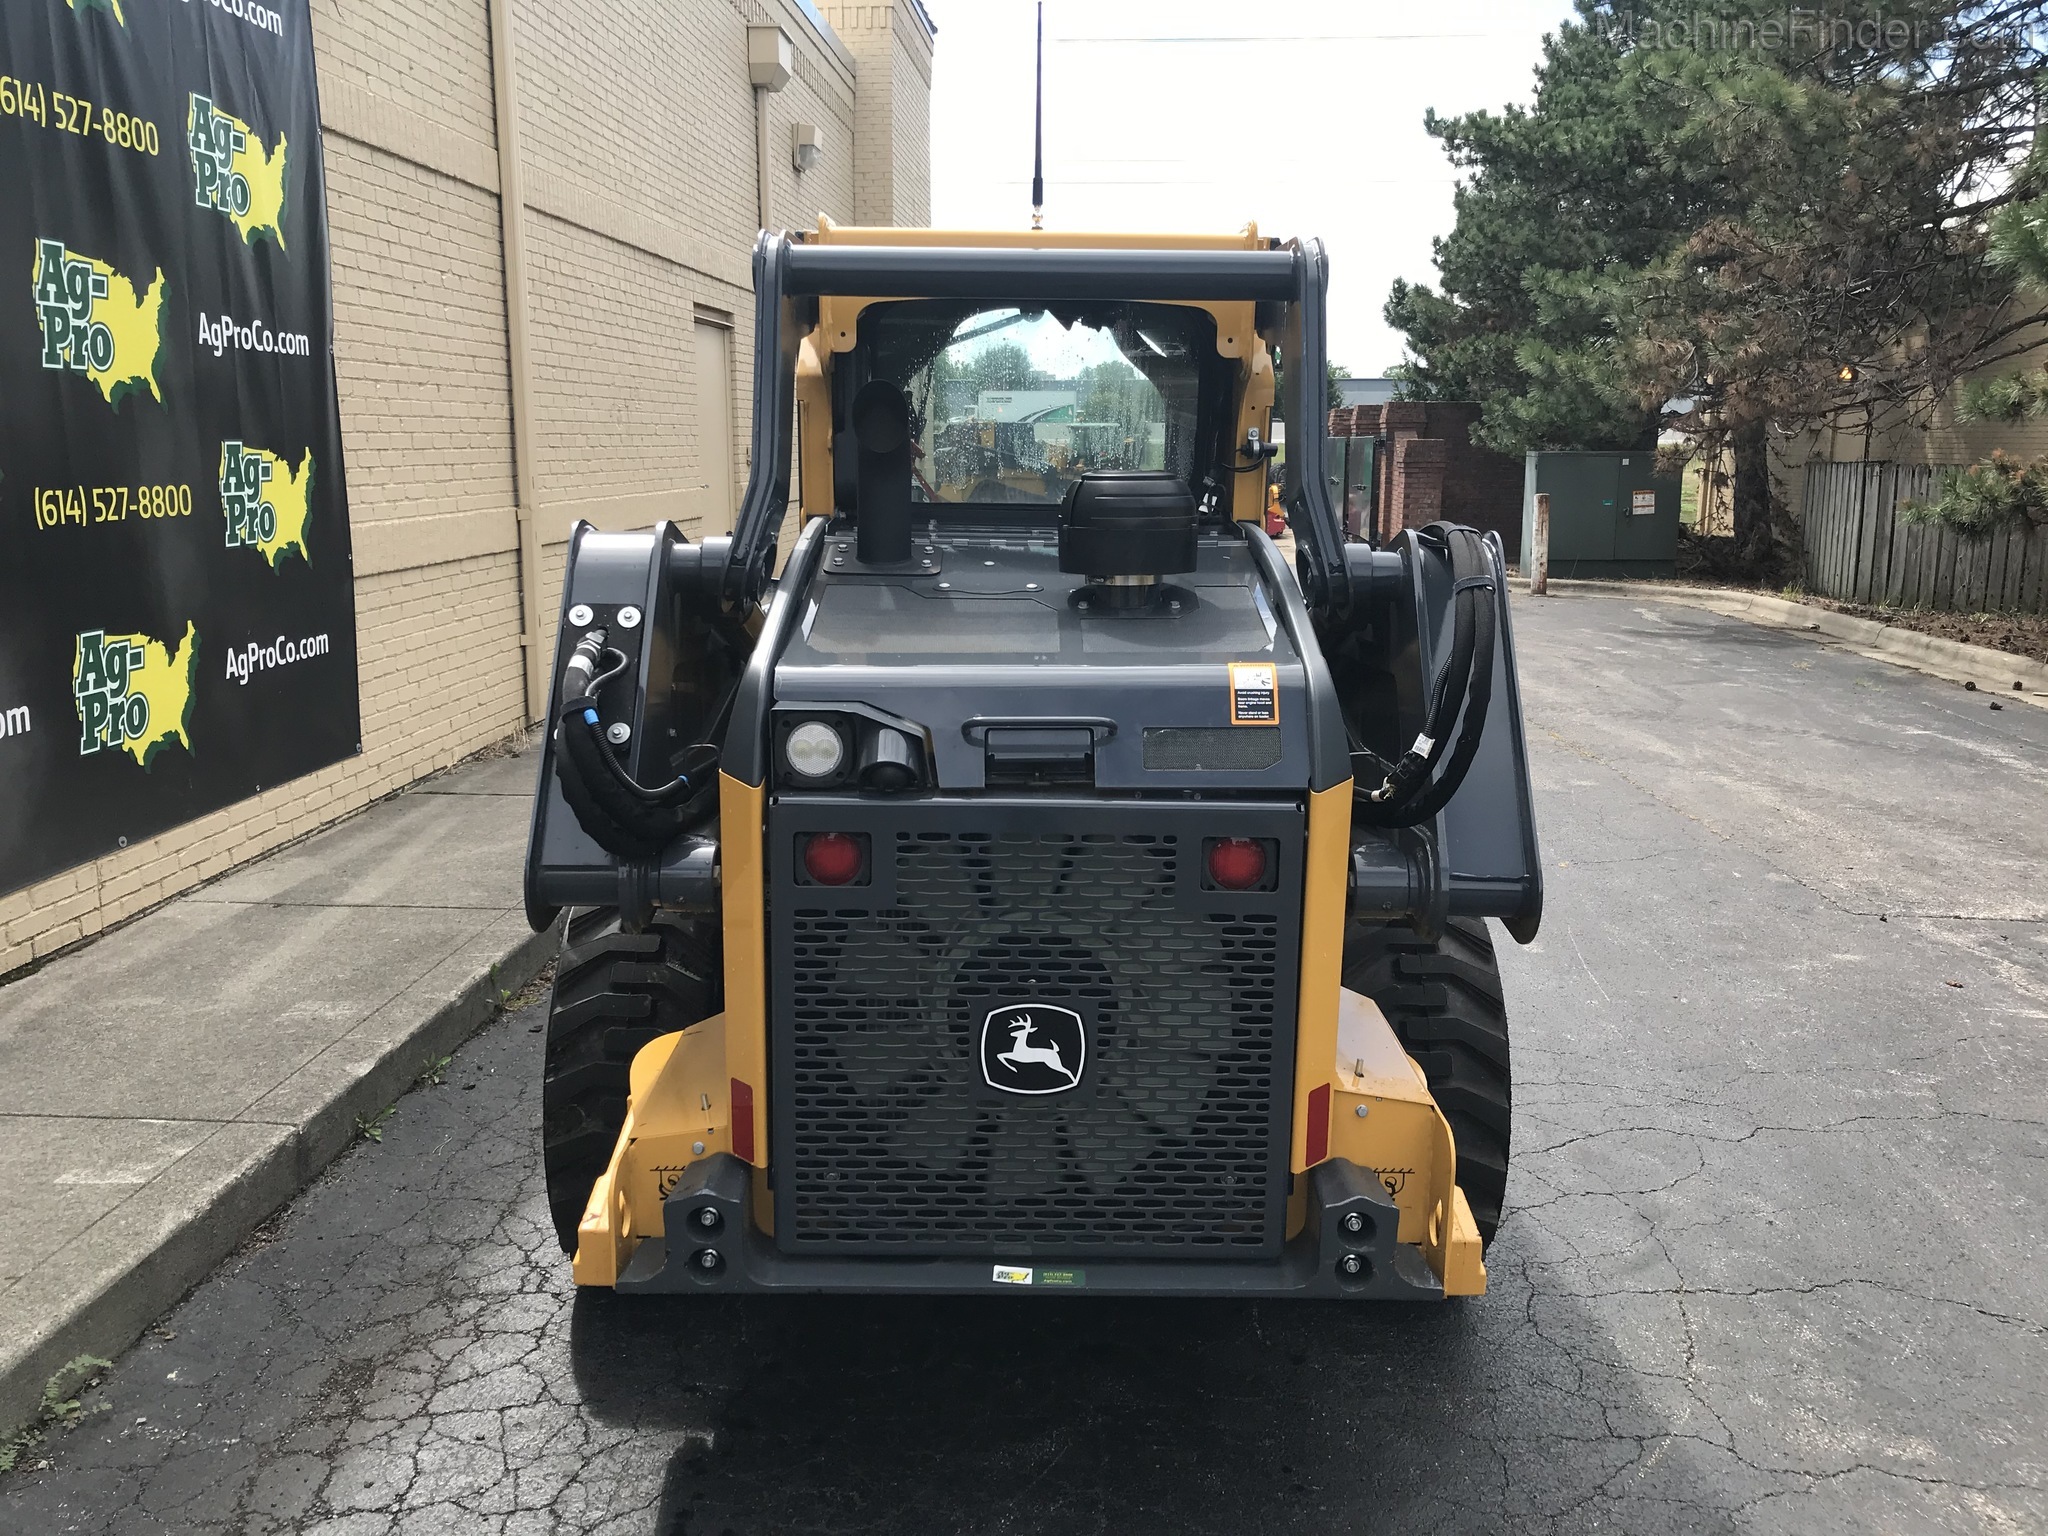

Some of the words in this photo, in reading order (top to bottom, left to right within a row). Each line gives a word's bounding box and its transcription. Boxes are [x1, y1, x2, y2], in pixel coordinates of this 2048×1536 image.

[0, 75, 46, 128] 614)
[53, 91, 159, 156] 527-8800
[189, 93, 247, 171] Ag-
[191, 150, 251, 216] Pro
[36, 239, 108, 321] Ag-
[40, 303, 114, 371] Pro
[198, 312, 310, 357] AgProCo.com
[221, 441, 272, 503] Ag-
[34, 485, 87, 530] (614)
[93, 484, 192, 523] 527-8800
[223, 494, 277, 547] Pro
[76, 630, 145, 698] Ag-
[225, 632, 329, 685] AgProCo.com
[80, 691, 149, 756] Pro
